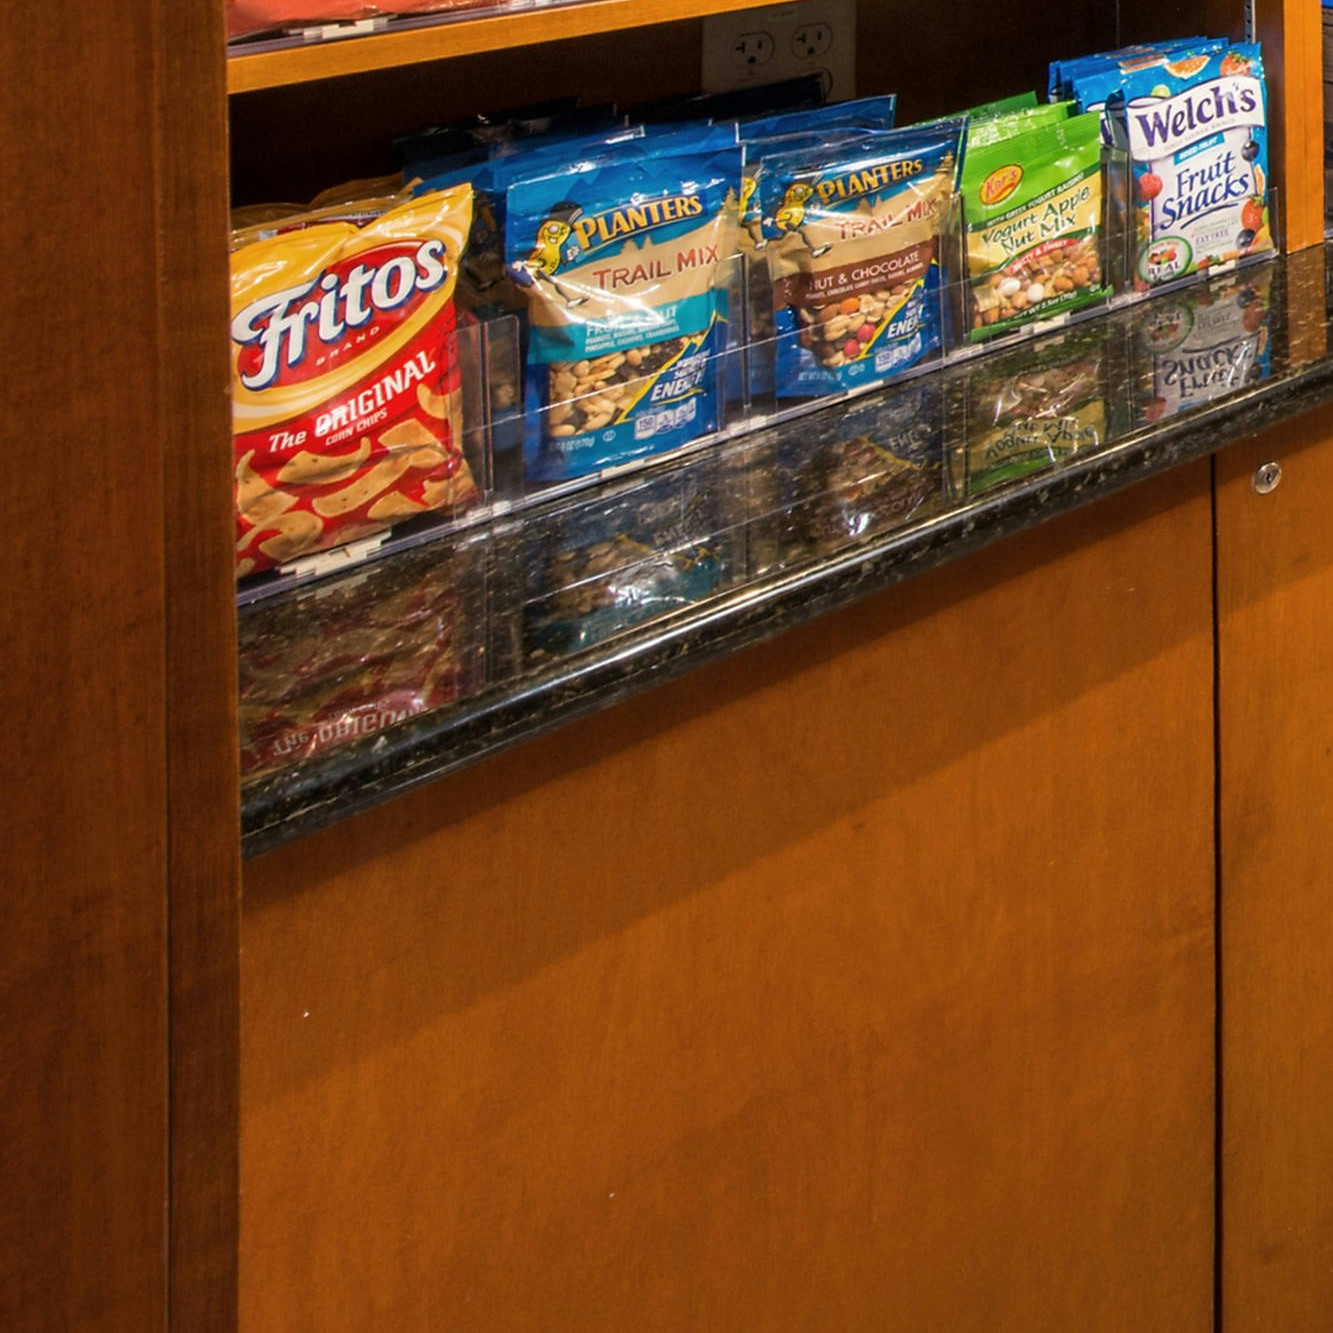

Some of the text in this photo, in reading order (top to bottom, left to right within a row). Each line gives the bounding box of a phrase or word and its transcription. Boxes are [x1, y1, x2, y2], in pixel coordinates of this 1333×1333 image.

[1135, 80, 1257, 148] Welch's
[816, 157, 923, 206] PLANTERS
[983, 168, 1019, 199] Kar's
[1176, 150, 1236, 200] Fruit
[576, 193, 704, 248] PLANTERS
[834, 196, 941, 241] TRAIL MIX
[981, 185, 1091, 248] Yogurt Apple
[1159, 172, 1250, 231] Snacks
[999, 212, 1077, 257] Nut Mix
[1195, 227, 1230, 246] FAT FREE
[592, 243, 719, 291] TRAIL MIX
[809, 250, 920, 291] NUT & CHOCOLATE
[232, 238, 448, 393] Fritos
[315, 325, 381, 366] BRAND
[268, 346, 437, 454] The ORIGINAL
[324, 407, 388, 447] CORN CHIPS
